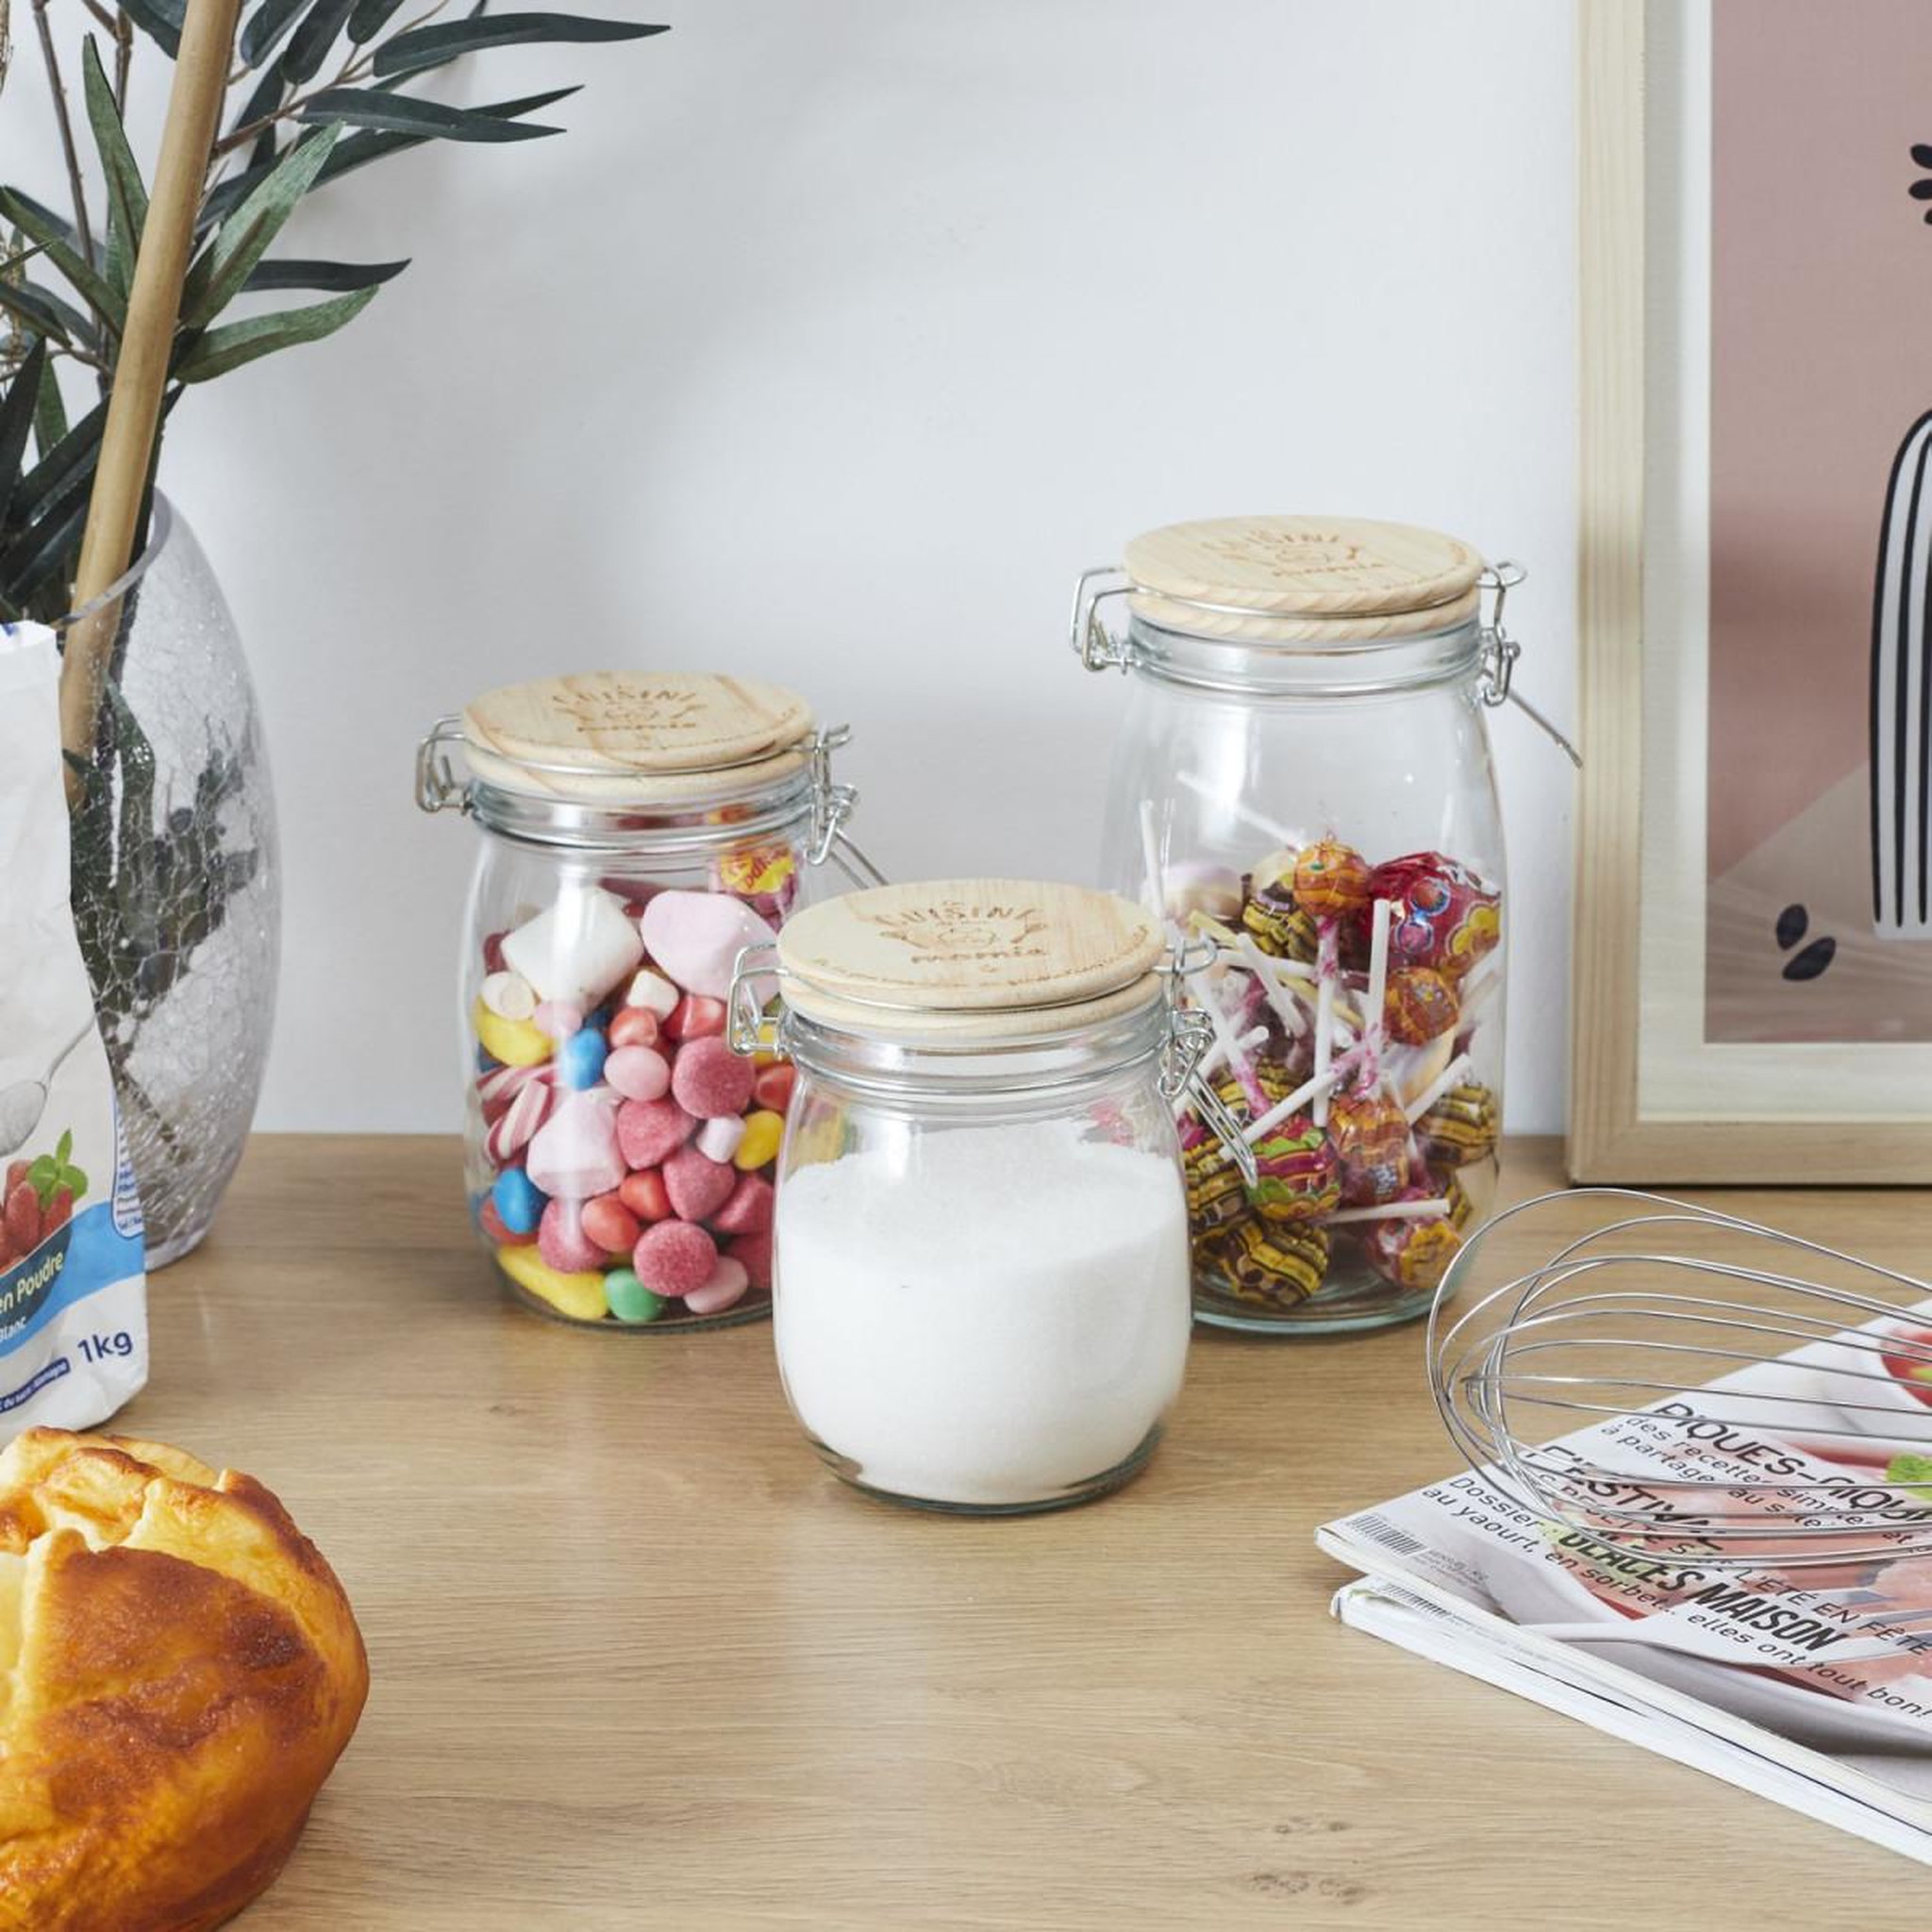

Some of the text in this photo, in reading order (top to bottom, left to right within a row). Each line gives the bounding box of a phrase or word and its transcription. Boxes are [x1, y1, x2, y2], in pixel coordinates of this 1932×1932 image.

[16, 1251, 64, 1303] Poudre
[77, 1331, 133, 1363] 1kg
[1624, 1415, 1674, 1441] des
[1602, 1424, 1623, 1436] à
[1617, 1434, 1718, 1483] partage
[1727, 1487, 1765, 1506] au
[1422, 1488, 1457, 1507] au
[1452, 1506, 1541, 1554] yaourt,
[1544, 1551, 1579, 1570] en
[1687, 1612, 1755, 1644] elles
[1757, 1642, 1807, 1665] ont
[1807, 1662, 1869, 1691] tout
[1449, 1476, 1544, 1528] Dossier
[1685, 1582, 1850, 1652] MAISON
[1811, 1602, 1860, 1624] EN
[1857, 1621, 1932, 1656] FÊTE
